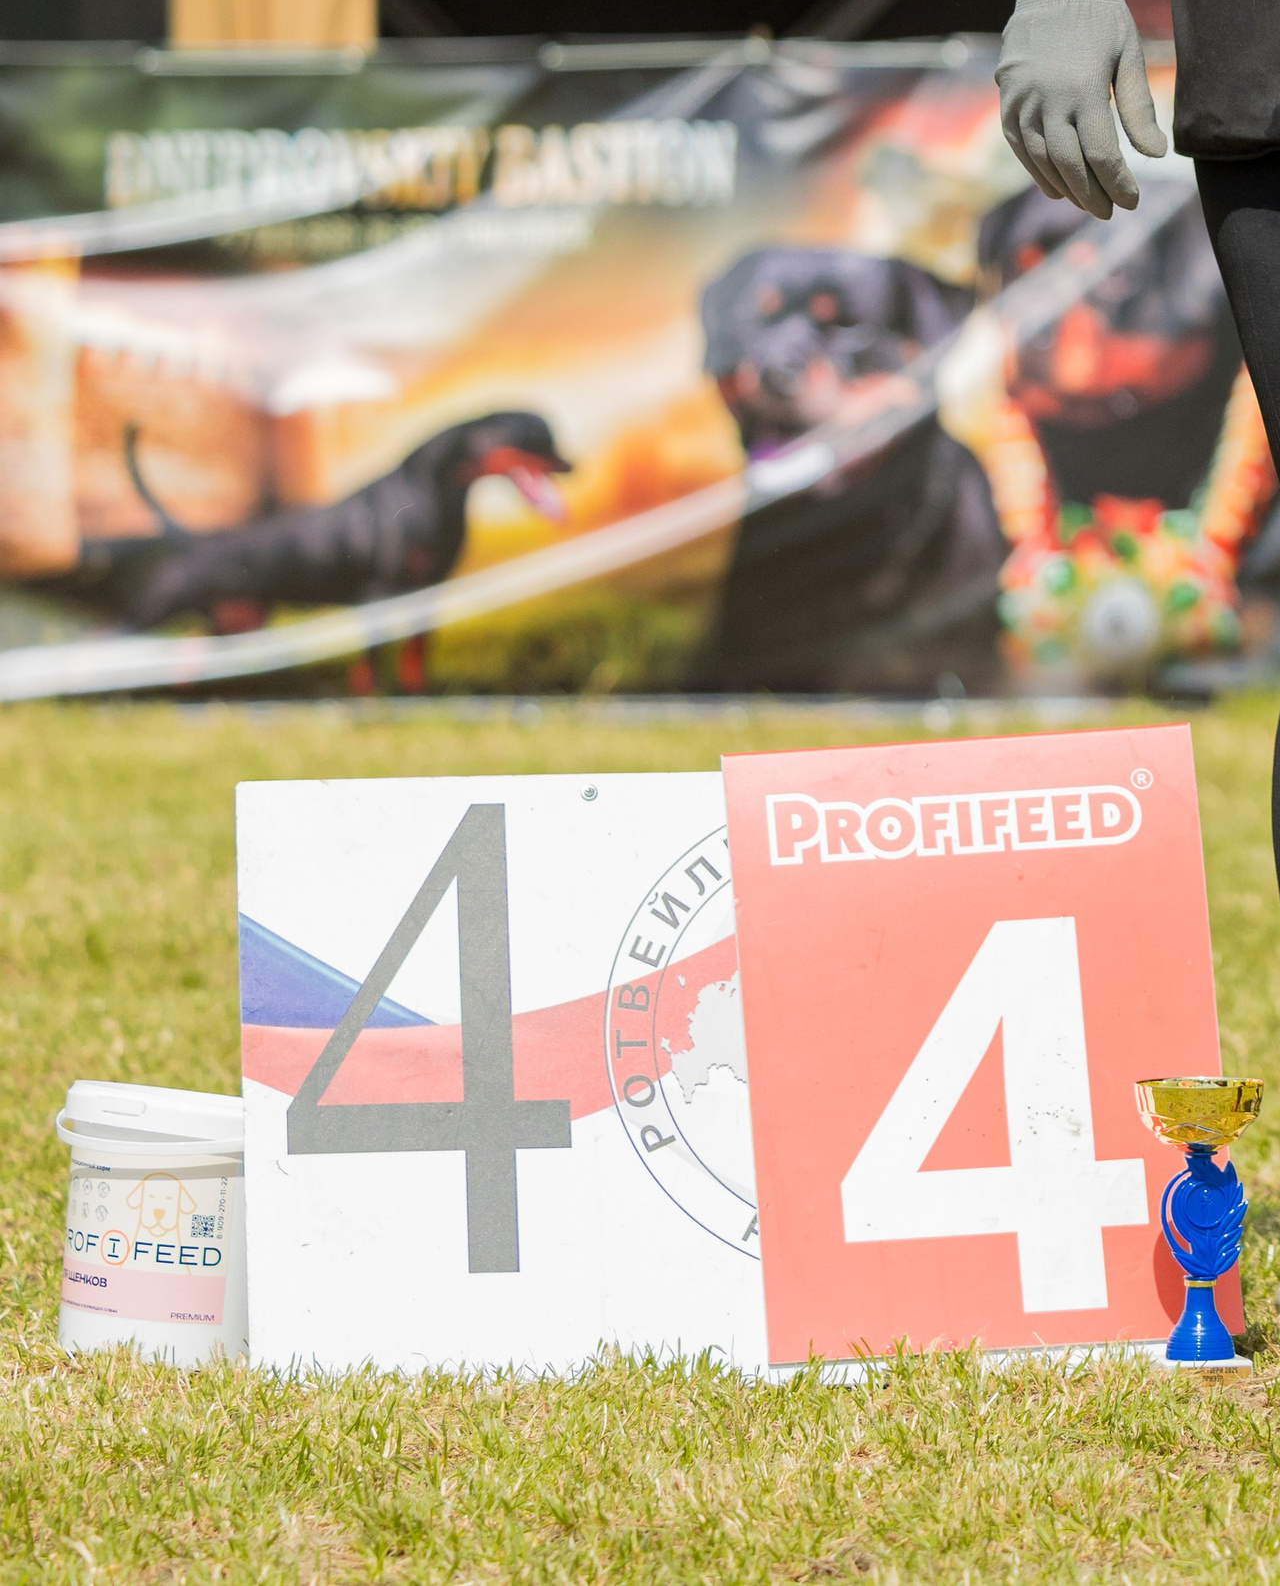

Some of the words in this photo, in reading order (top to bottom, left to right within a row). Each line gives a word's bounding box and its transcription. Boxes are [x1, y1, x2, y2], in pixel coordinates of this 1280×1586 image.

[287, 802, 573, 1274] 4
[615, 838, 730, 1154] РОТВЕЙЛ
[840, 916, 1151, 1314] 4
[170, 1312, 215, 1322] PREMIUM
